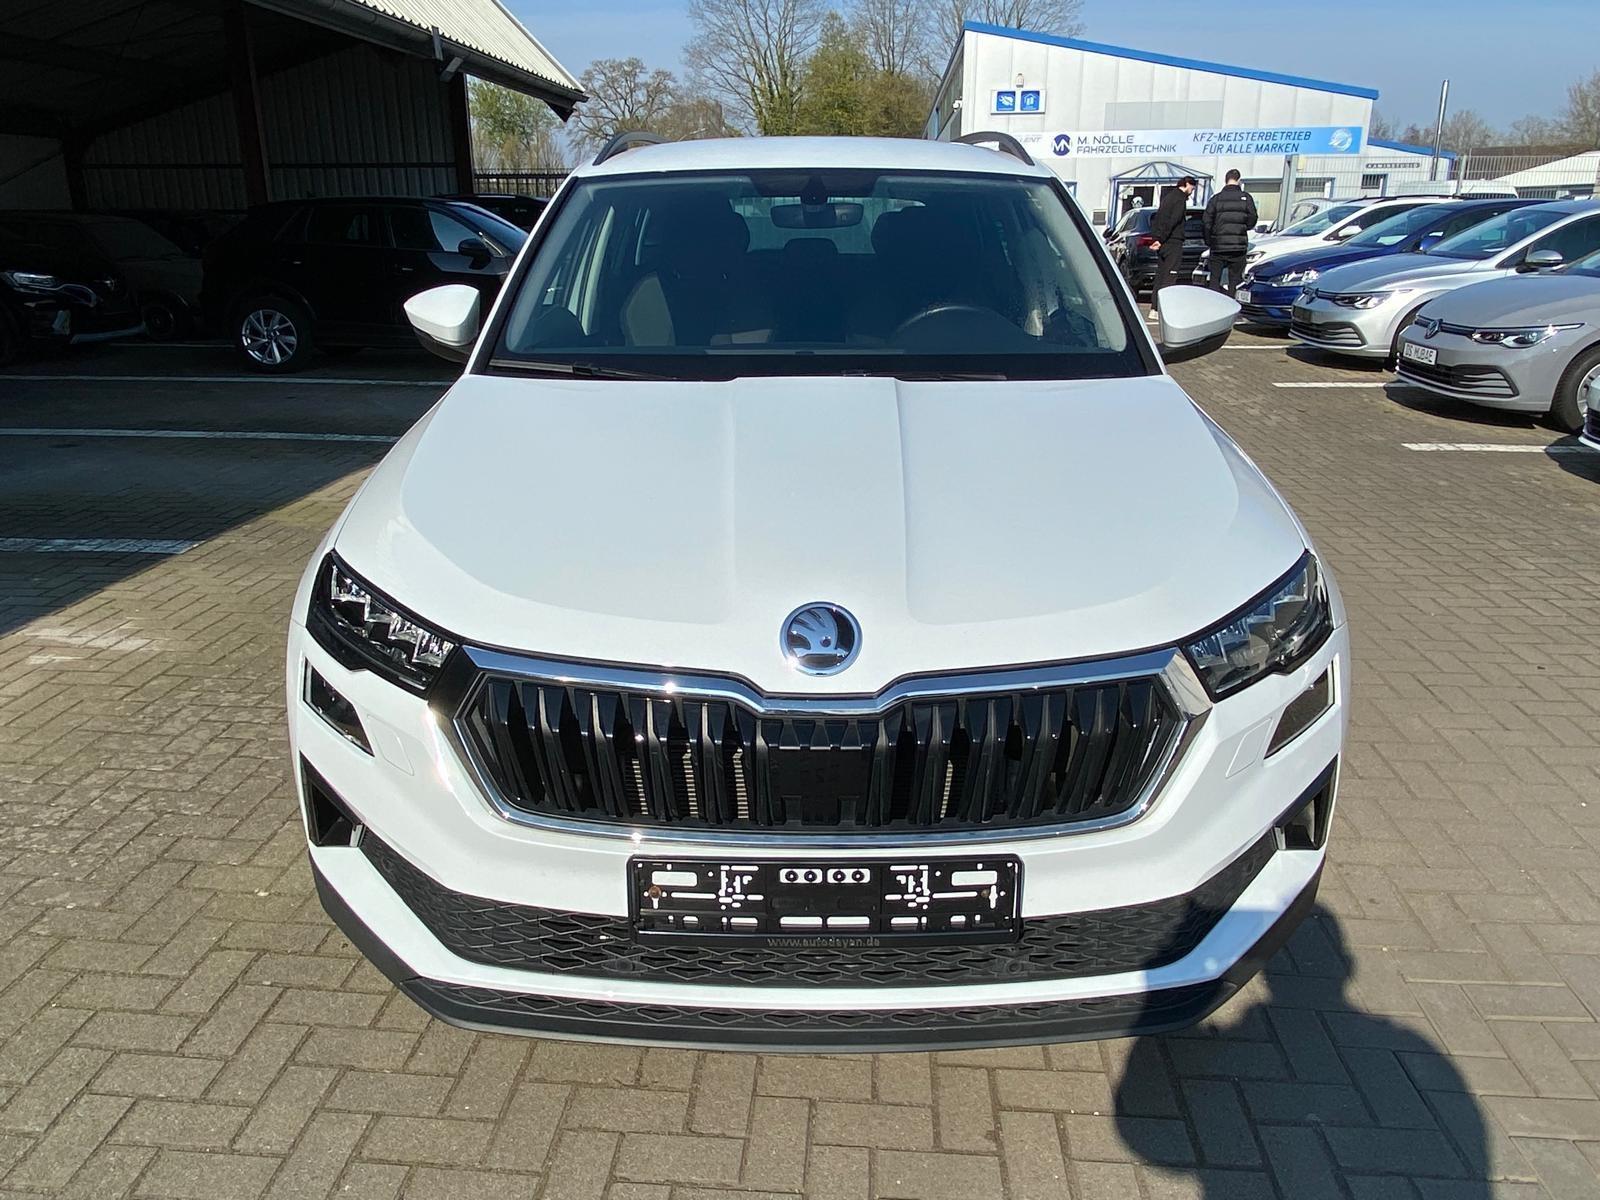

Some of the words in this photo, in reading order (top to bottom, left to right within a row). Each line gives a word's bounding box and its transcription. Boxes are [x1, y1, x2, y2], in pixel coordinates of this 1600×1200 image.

[1077, 136, 1089, 145] M.
[1093, 133, 1135, 145] NÖLLE
[1193, 131, 1312, 143] KFZ-MEISTERBETRIEB
[1077, 144, 1177, 154] FAHRZEUGTECHNIK
[1202, 143, 1223, 154] FÜR
[1225, 143, 1252, 154] ALLE
[1254, 142, 1299, 153] MARKEN
